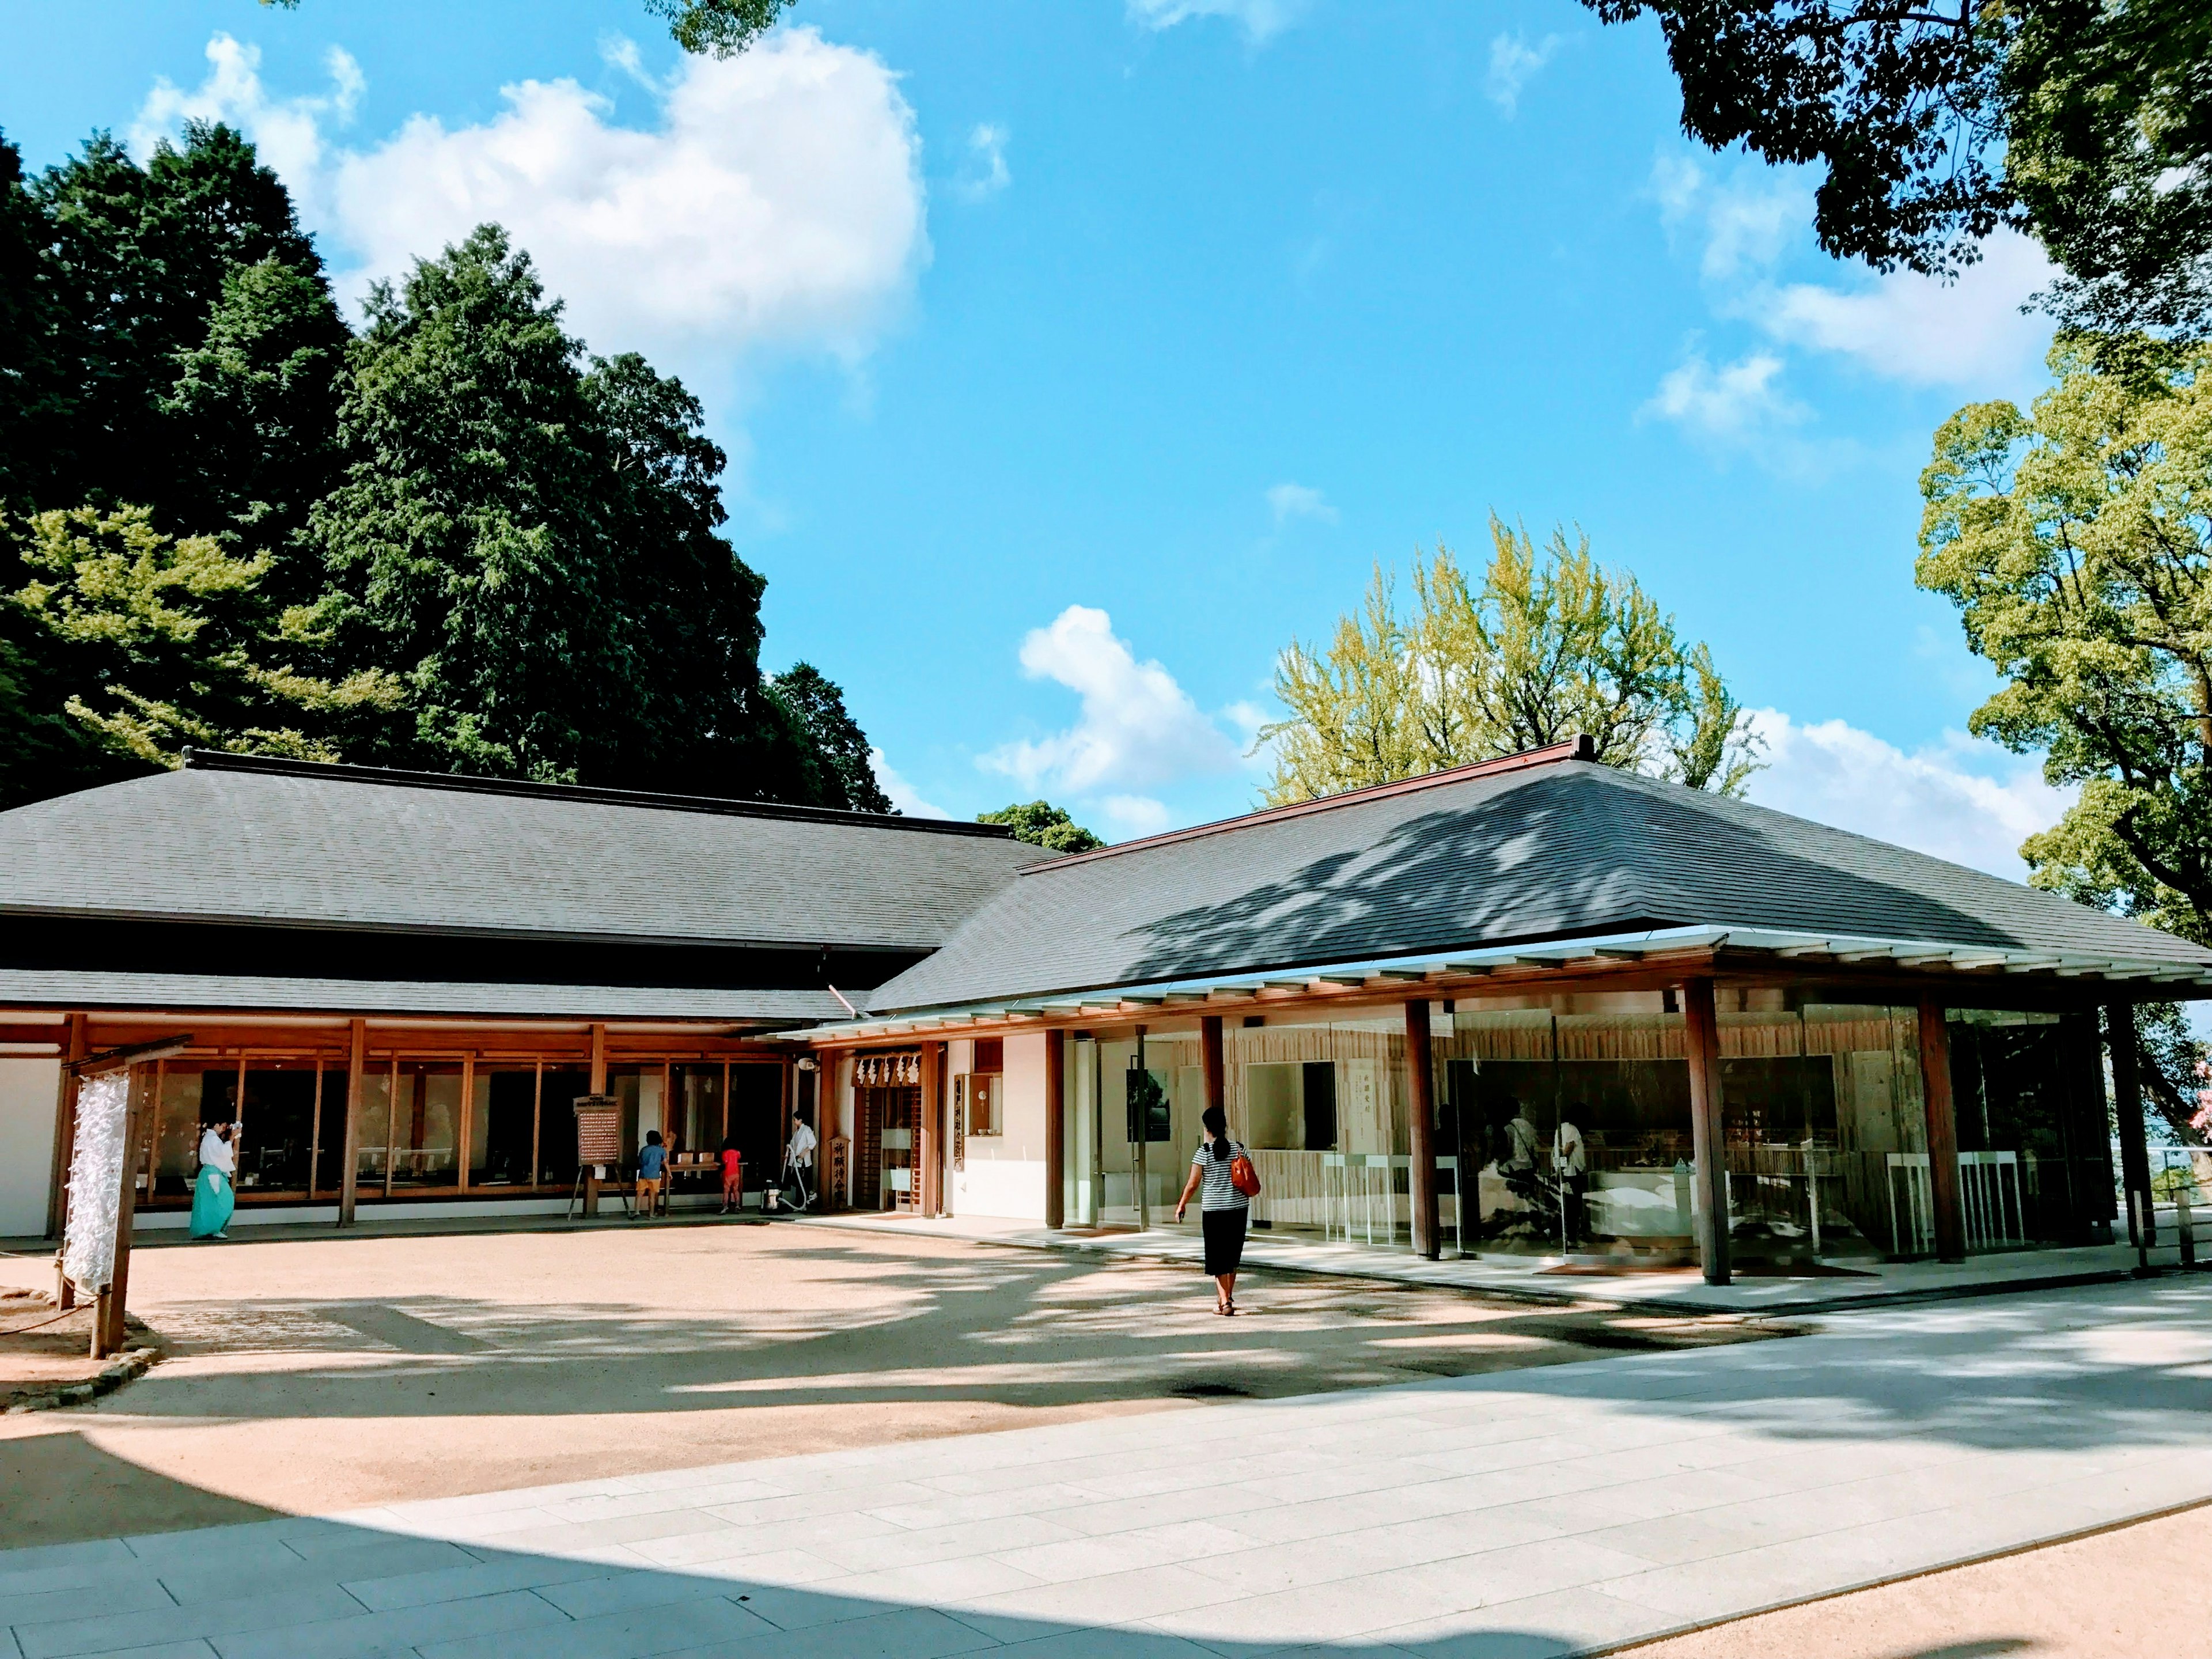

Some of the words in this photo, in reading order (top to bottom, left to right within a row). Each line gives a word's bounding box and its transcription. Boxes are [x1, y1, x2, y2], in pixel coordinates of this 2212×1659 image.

[834, 1142, 845, 1202] 祈願待合室
